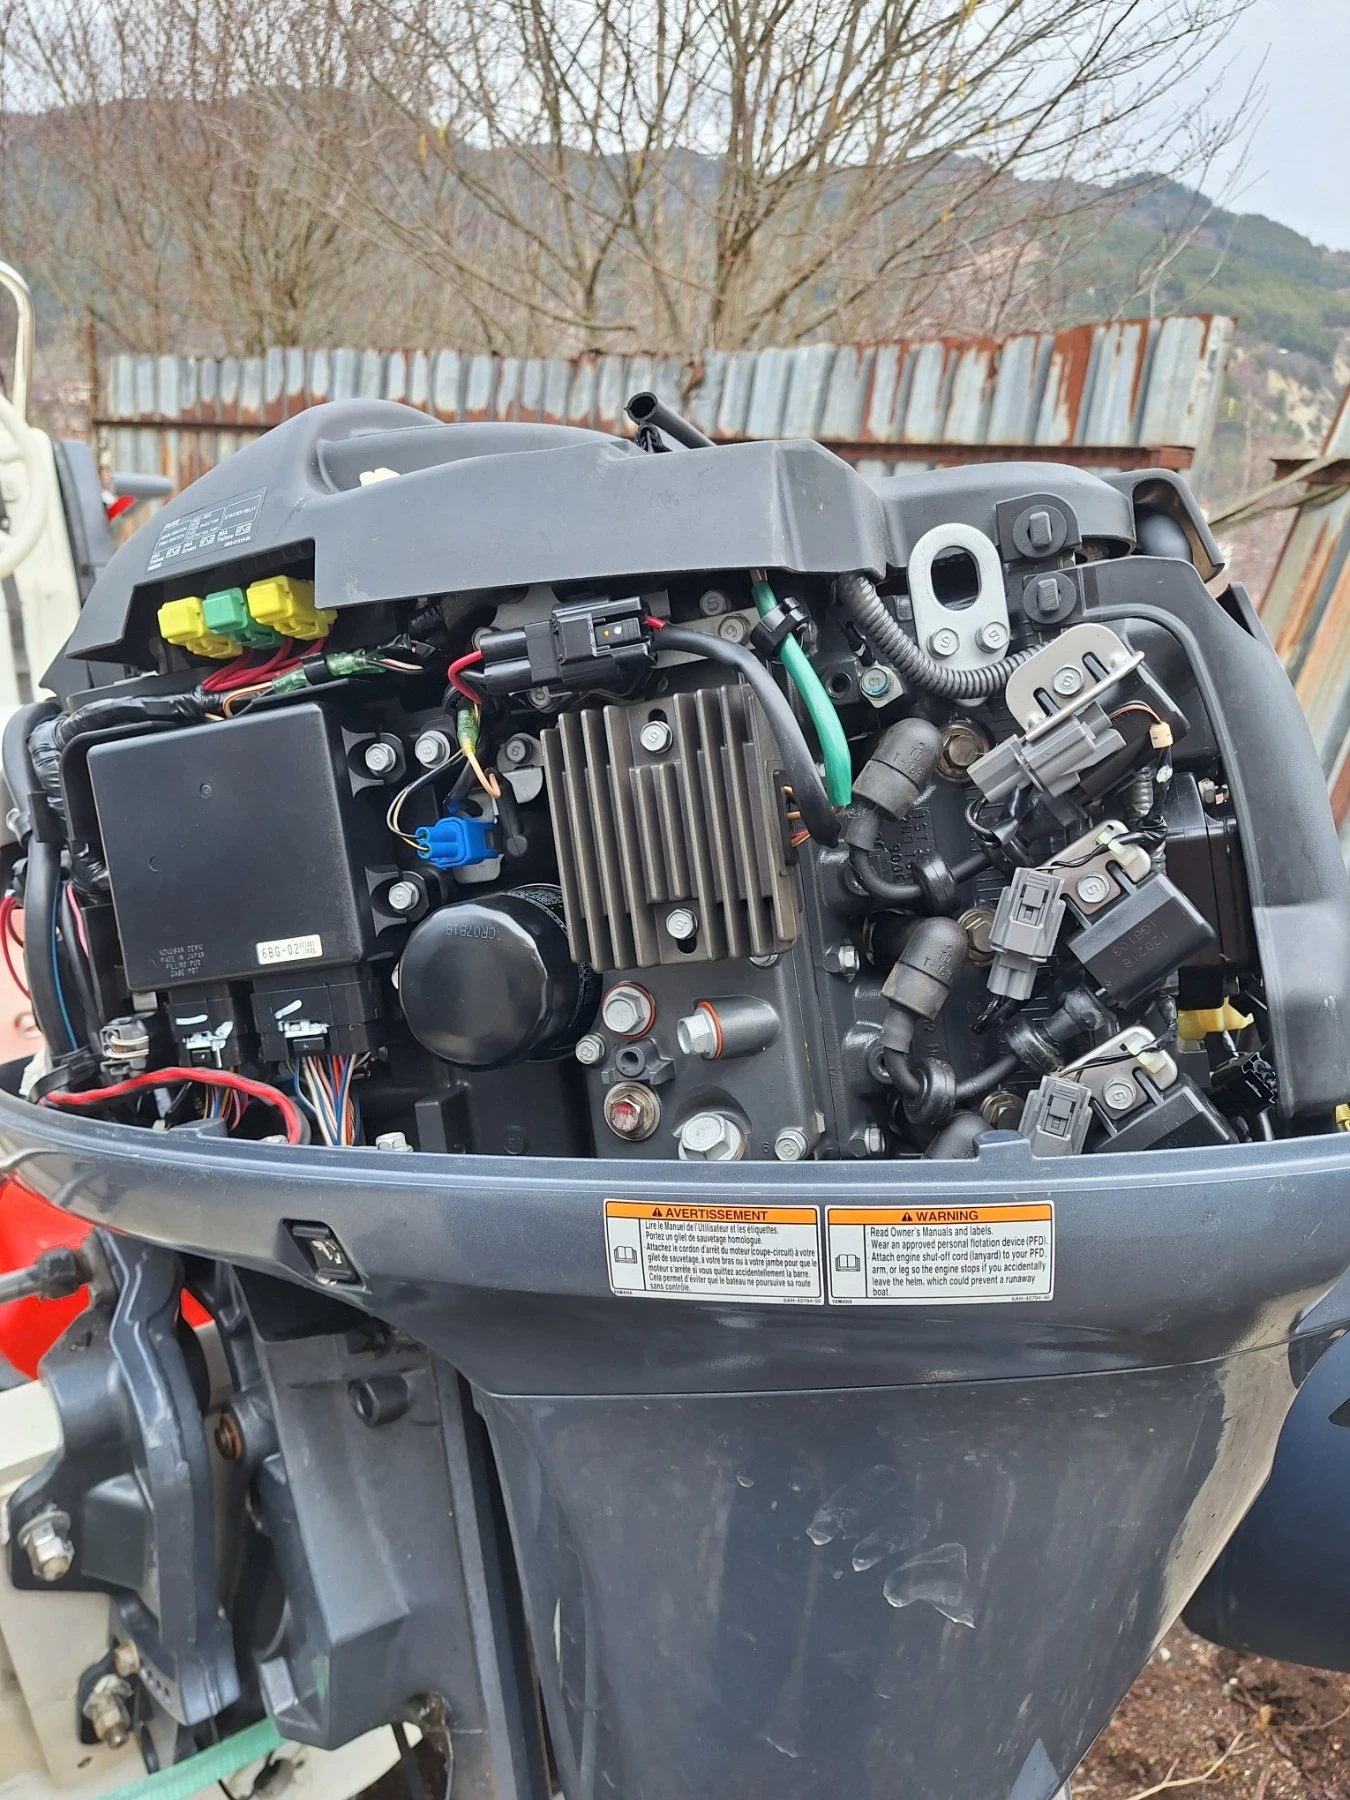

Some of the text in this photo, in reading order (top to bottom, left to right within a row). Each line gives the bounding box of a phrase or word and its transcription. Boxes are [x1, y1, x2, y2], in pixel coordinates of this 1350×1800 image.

[262, 943, 299, 959] 6BG-02
[666, 1208, 768, 1220] AVERTISSEMENT
[916, 1211, 978, 1221] WARNING
[646, 1220, 656, 1230] Lire
[658, 1221, 663, 1230] le
[664, 1222, 686, 1231] Manuel
[686, 1222, 694, 1231] de
[737, 1225, 746, 1234] les
[870, 1226, 994, 1237] Read Owner's Manuals and labels.
[646, 1231, 664, 1241] Portez
[674, 1232, 687, 1243] gilet
[688, 1233, 695, 1242] de
[697, 1234, 726, 1245] sauvetage
[871, 1240, 890, 1249] Wear
[902, 1240, 936, 1251] approved
[937, 1239, 968, 1251] personal
[970, 1238, 1000, 1248] flotation
[1002, 1237, 1025, 1247] device
[1026, 1236, 1049, 1246] (PFD).
[646, 1243, 671, 1252] Attachez
[672, 1244, 678, 1252] le
[680, 1244, 699, 1253] cordon
[721, 1246, 728, 1255] du
[730, 1247, 750, 1255] moteur
[751, 1248, 794, 1258] (coupe-circuit)
[795, 1248, 799, 1256] à
[800, 1249, 815, 1257] votre
[872, 1252, 894, 1262] Attach
[896, 1252, 920, 1264] engine
[922, 1251, 950, 1262] shut-off
[952, 1251, 968, 1261] cord
[970, 1250, 1001, 1262] (lanyard)
[1002, 1250, 1010, 1259] to
[1012, 1251, 1028, 1261] your
[648, 1253, 660, 1263] gilet
[701, 1255, 705, 1263] à
[706, 1256, 720, 1265] votre
[722, 1257, 734, 1265] bras
[744, 1257, 748, 1265] à
[765, 1258, 783, 1268] jambe
[785, 1260, 798, 1269] pour
[800, 1260, 810, 1270] que
[812, 1259, 817, 1267] le
[872, 1266, 888, 1275] arm,
[899, 1265, 910, 1276] leg
[922, 1265, 933, 1274] the
[935, 1265, 958, 1275] engine
[960, 1264, 980, 1275] stops
[982, 1263, 987, 1272] if
[988, 1264, 1002, 1274] you
[1004, 1261, 1046, 1272] accidentally
[648, 1264, 668, 1273] moteur
[692, 1265, 697, 1273] si
[699, 1267, 712, 1275] vous
[714, 1267, 734, 1277] quittez
[735, 1268, 785, 1277] accidentellement
[786, 1269, 792, 1278] la
[649, 1273, 662, 1281] Cela
[663, 1275, 682, 1284] permet
[708, 1277, 719, 1286] que
[726, 1278, 746, 1286] bateau
[756, 1279, 786, 1288] poursuive
[872, 1278, 890, 1286] leave
[892, 1278, 904, 1286] the
[927, 1276, 947, 1286] which
[949, 1276, 969, 1285] could
[970, 1276, 998, 1286] prevent
[1006, 1275, 1035, 1285] runaway
[873, 1288, 891, 1296] boat.
